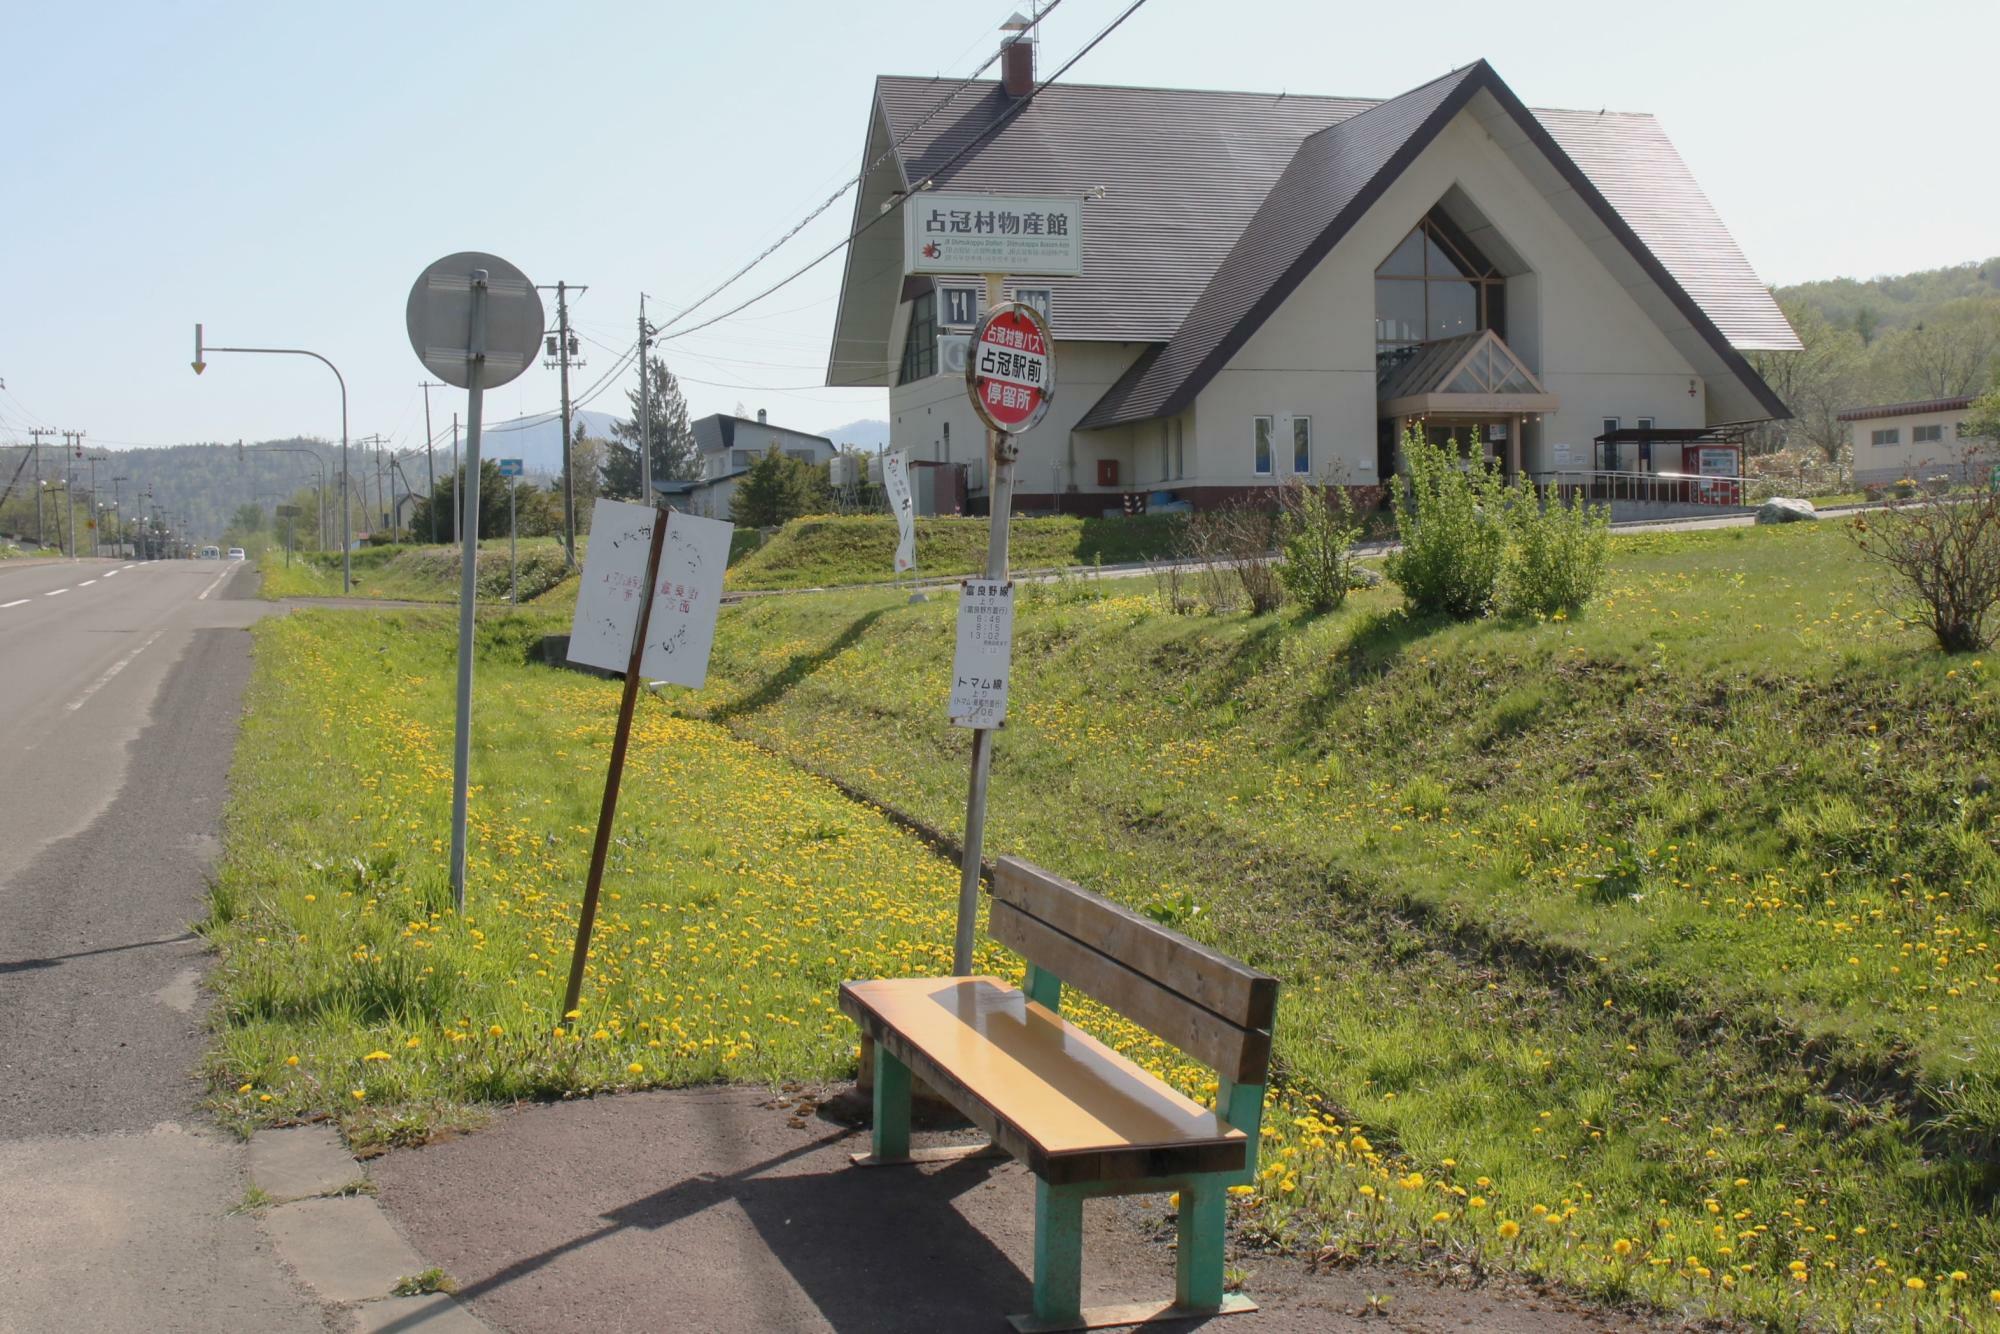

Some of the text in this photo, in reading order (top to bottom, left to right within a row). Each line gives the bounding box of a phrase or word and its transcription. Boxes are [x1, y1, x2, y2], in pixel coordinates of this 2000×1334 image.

[926, 209, 1068, 236] 占冠村物産館
[987, 325, 1040, 352] 占冠村営バス
[981, 347, 1042, 383] 占冠駅前
[987, 381, 1031, 411] 停留所
[966, 585, 1009, 598] 富良野線
[957, 676, 1003, 690] トマム線
